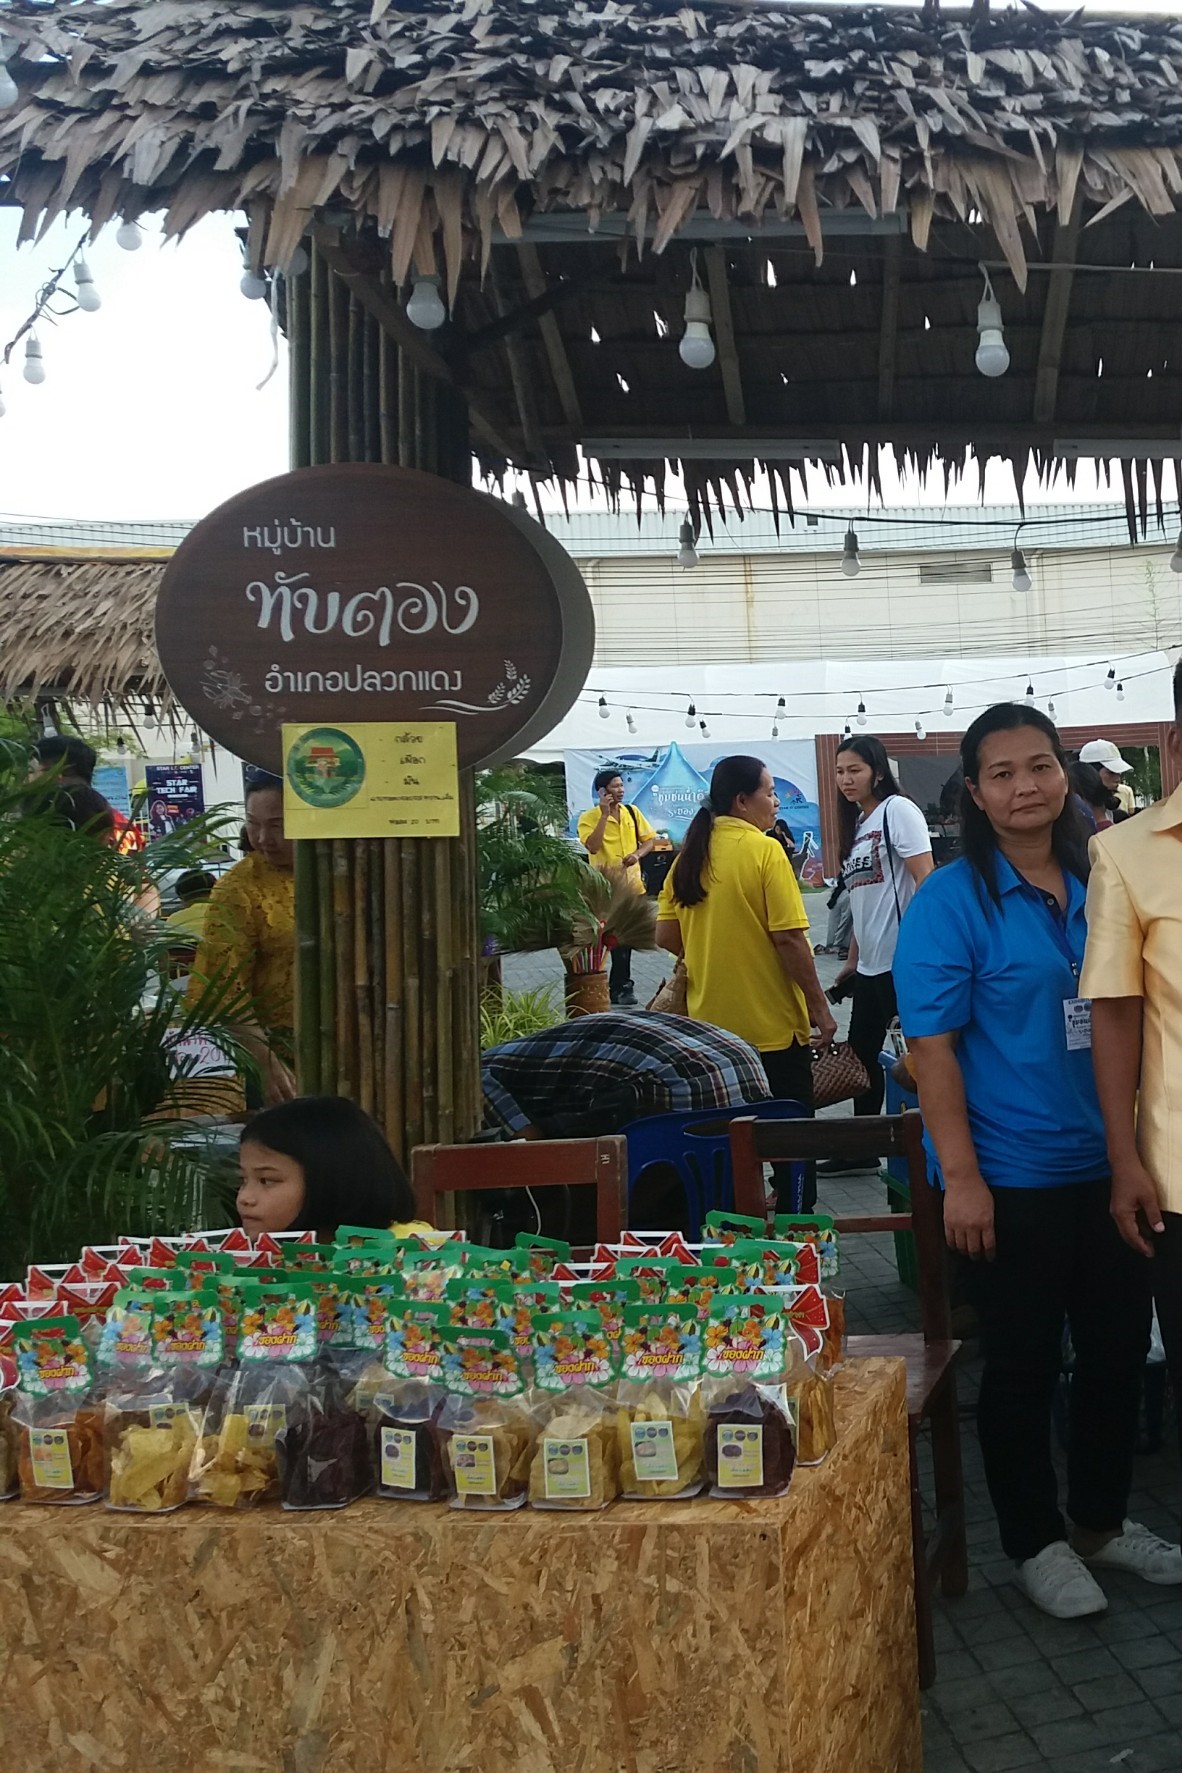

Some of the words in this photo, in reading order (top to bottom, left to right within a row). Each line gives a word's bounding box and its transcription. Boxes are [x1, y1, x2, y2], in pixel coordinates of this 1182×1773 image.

[243, 517, 336, 555] หมู่บ้าน
[246, 571, 480, 646] ทับตอง
[264, 664, 462, 693] อำเภอปลวกแดง
[259, 1335, 297, 1346] ของฝาก
[403, 1352, 438, 1364] ของฝาก
[641, 1354, 683, 1366] ของฝาก
[722, 1349, 764, 1361] ของฝาก
[554, 1361, 596, 1374] ของฝาก
